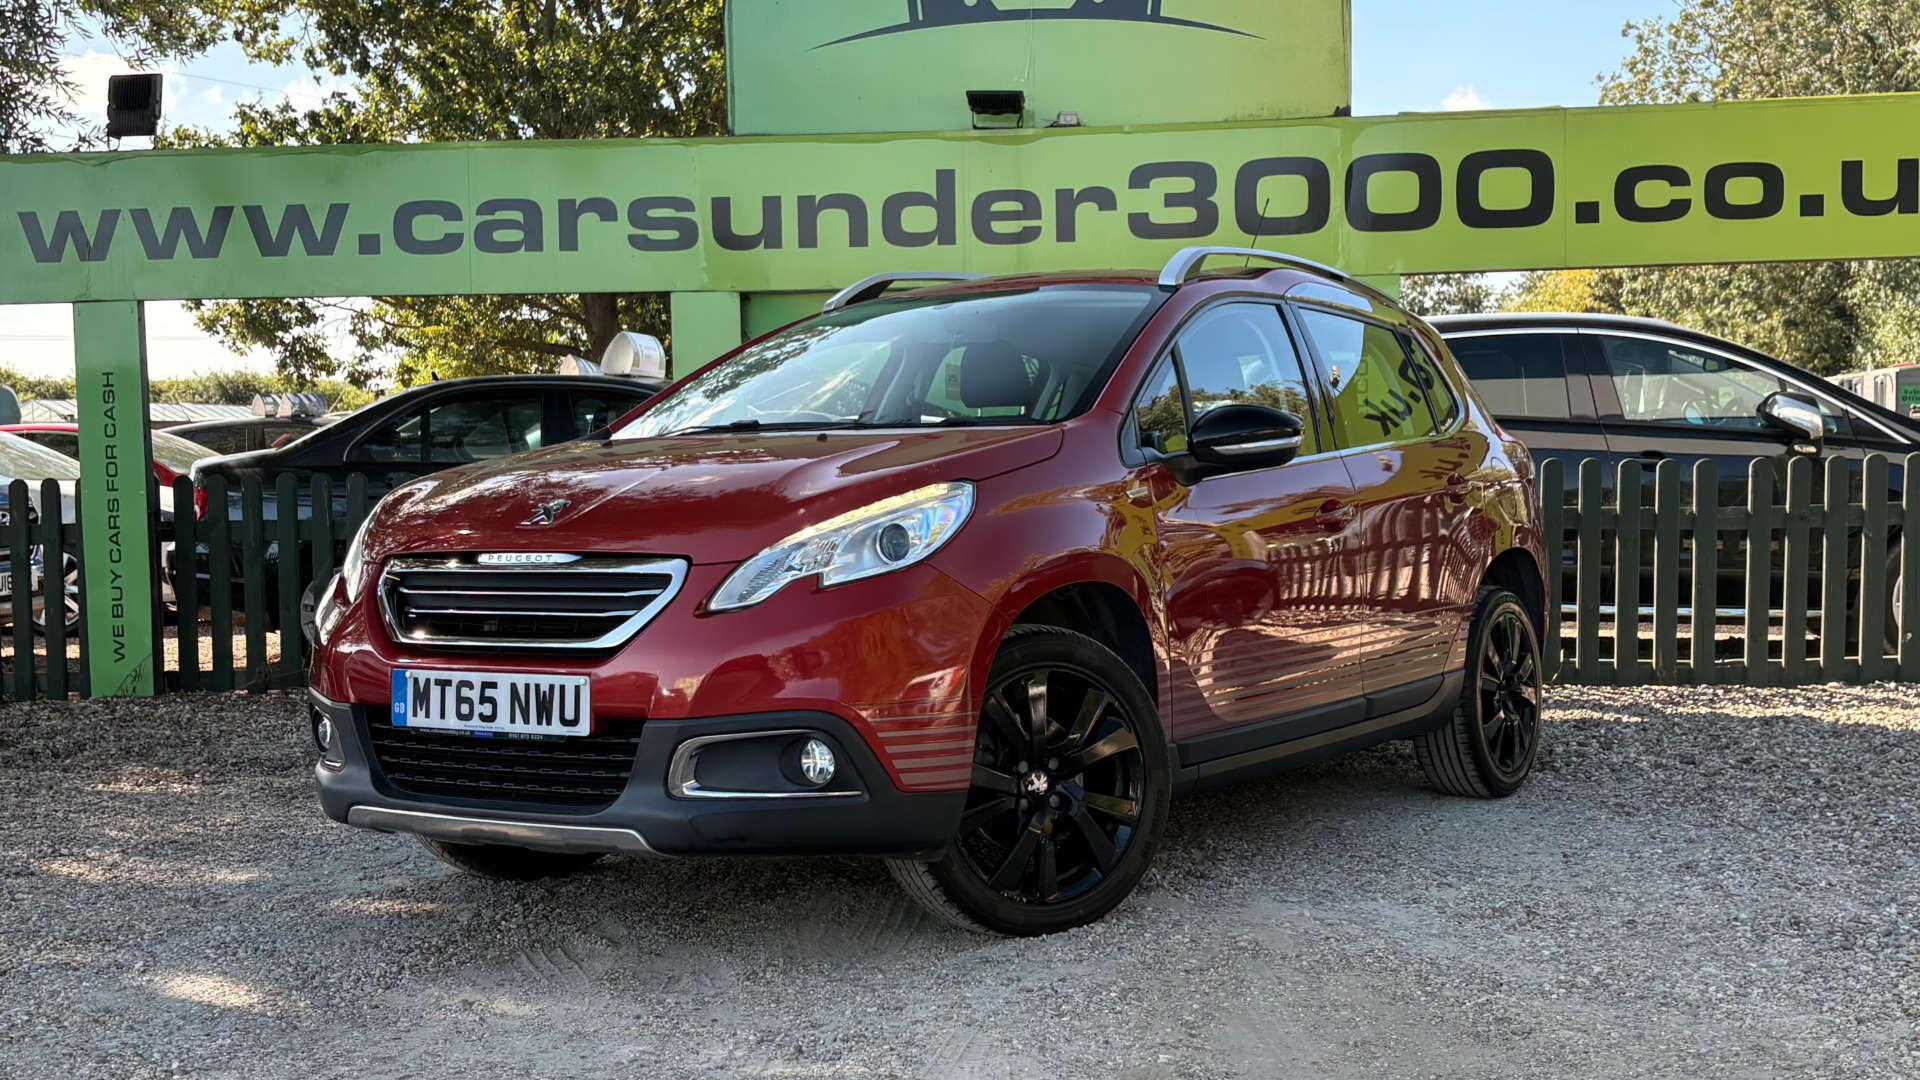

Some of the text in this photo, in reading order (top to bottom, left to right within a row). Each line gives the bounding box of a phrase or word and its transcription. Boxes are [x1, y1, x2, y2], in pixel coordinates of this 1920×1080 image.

[102, 371, 126, 663] WE BUY CARS FOR CASH
[488, 554, 553, 562] PEUGEOT
[394, 702, 405, 714] GB
[411, 676, 581, 728] MT65 NWU
